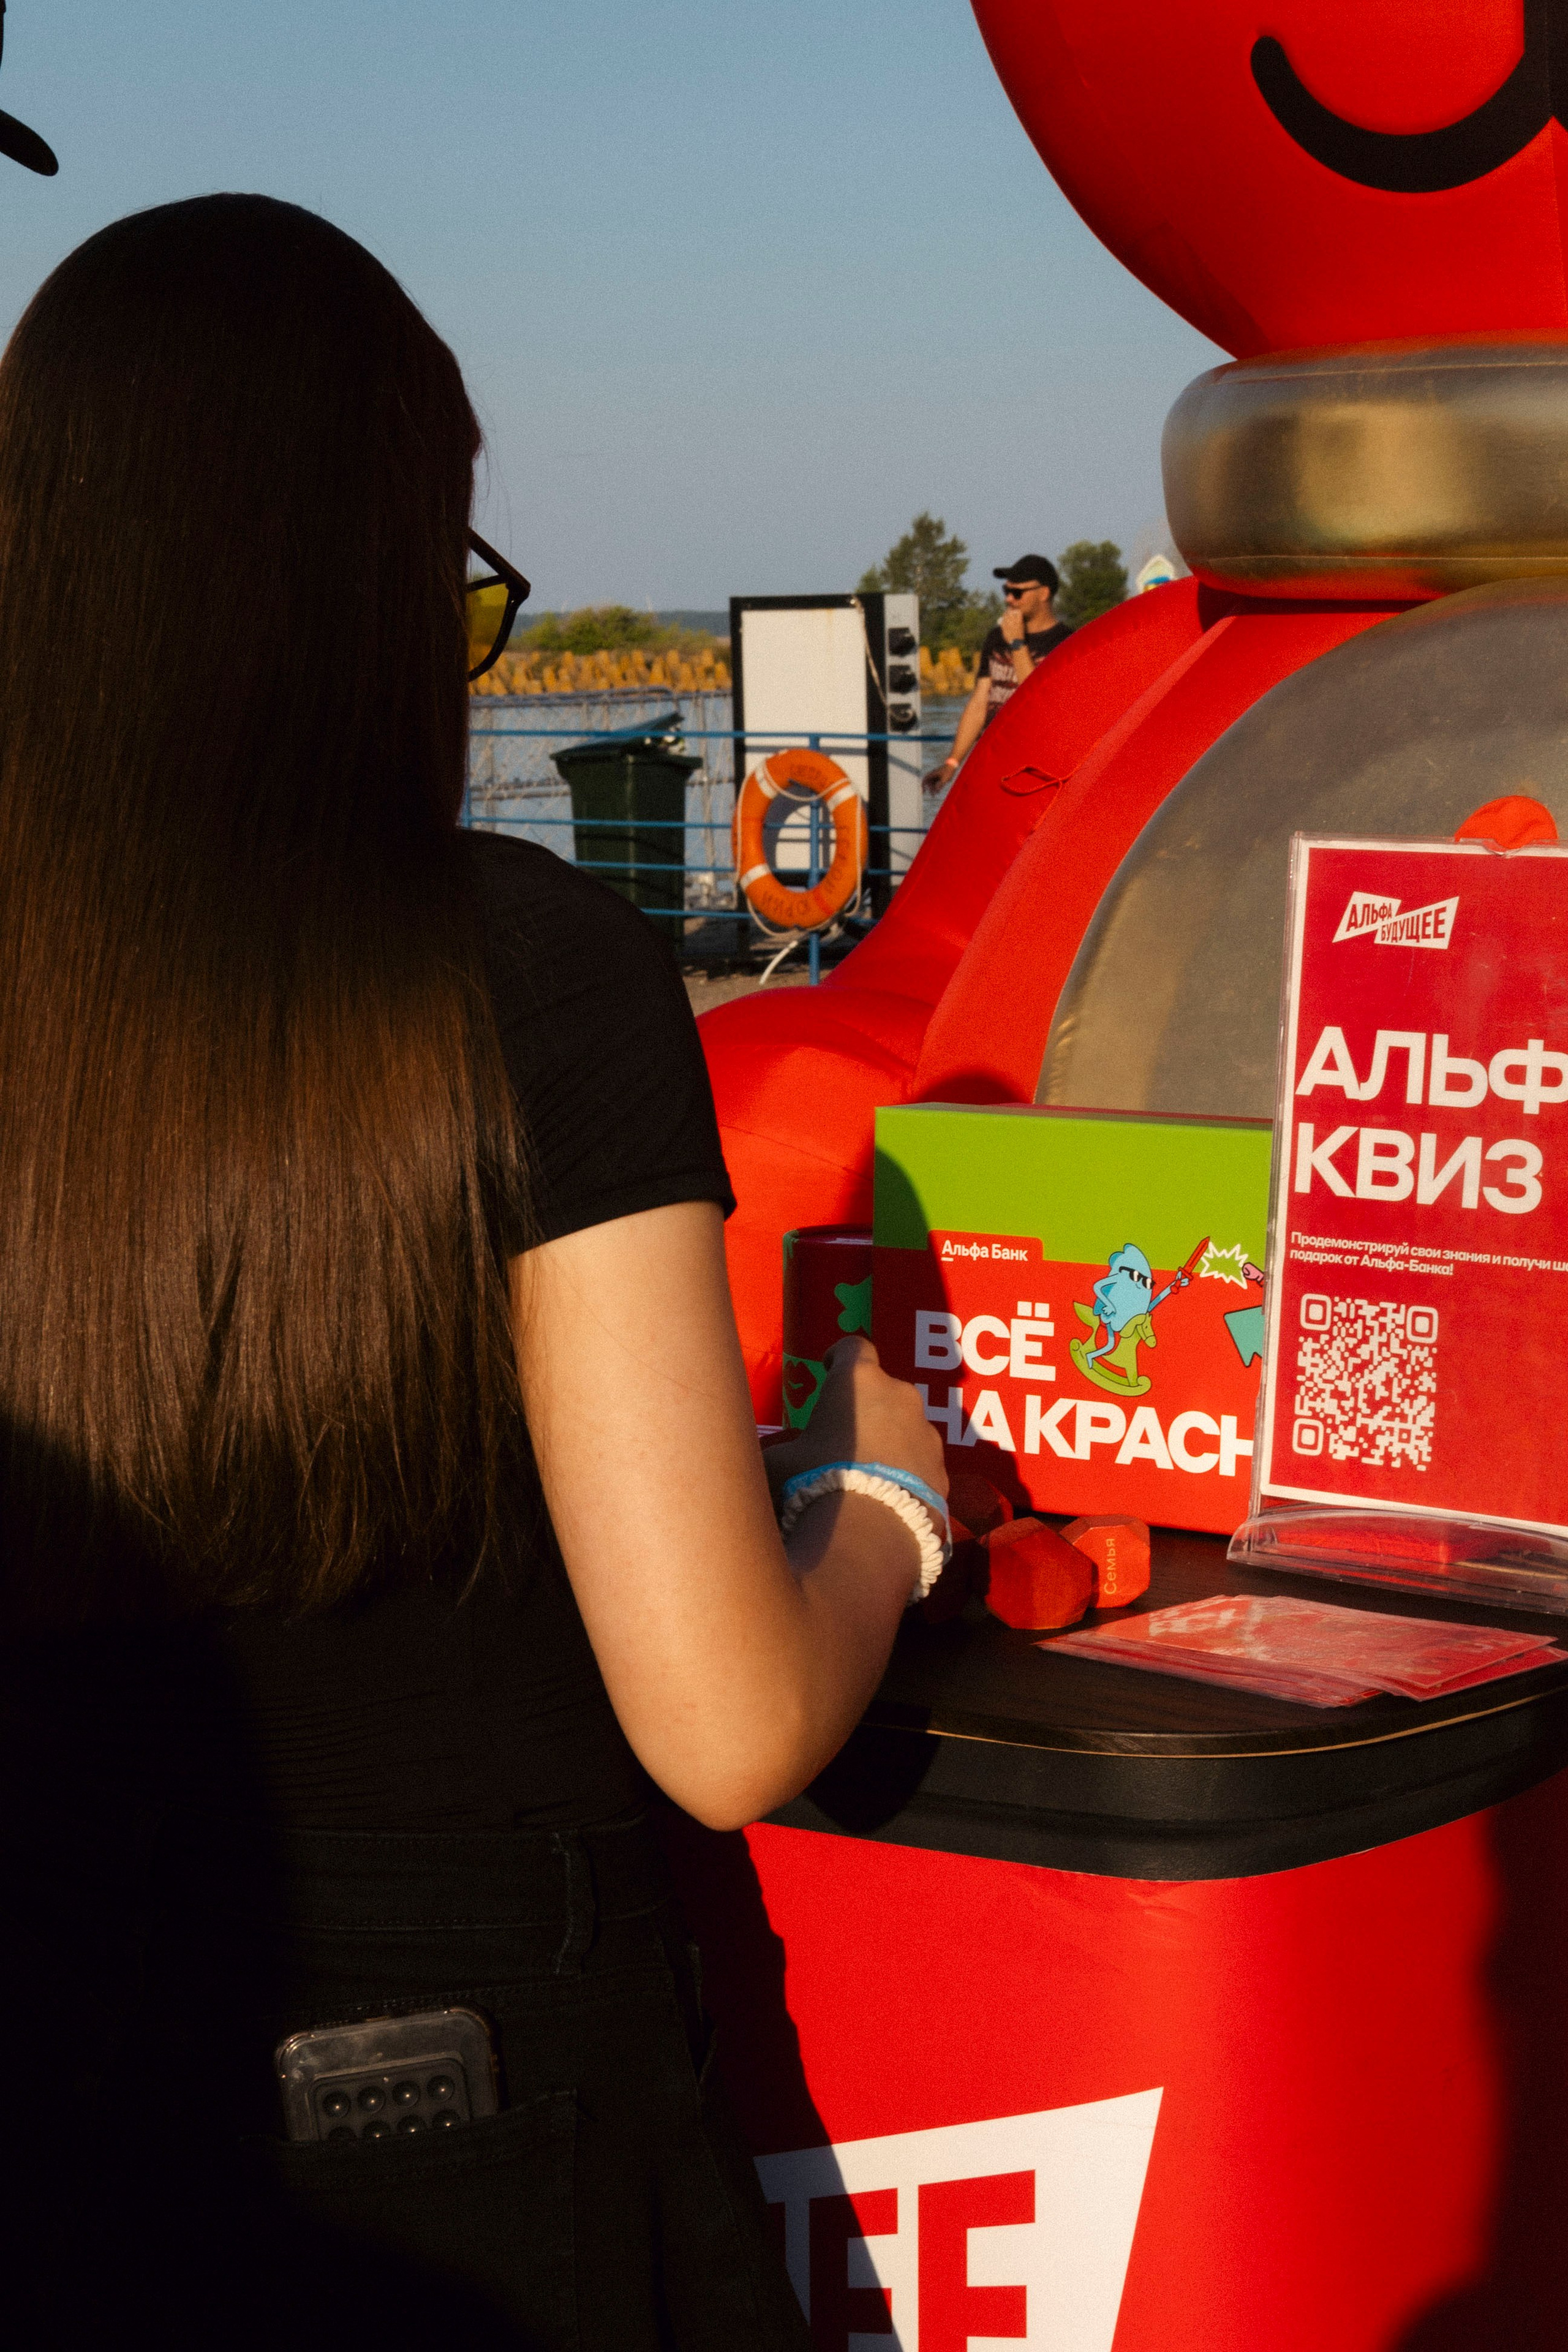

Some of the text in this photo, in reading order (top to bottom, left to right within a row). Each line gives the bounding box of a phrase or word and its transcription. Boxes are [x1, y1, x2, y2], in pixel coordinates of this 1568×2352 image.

[1346, 903, 1392, 932] АЛЬФА
[1381, 906, 1447, 943] БУДУЩЕЕ
[1295, 1026, 1568, 1114] АЛЬФ
[1294, 1123, 1544, 1214] КВИЗ
[941, 1240, 1028, 1261] Альфа Банк
[1290, 1249, 1453, 1276] подарок от Альфа-Банка!
[1291, 1231, 1409, 1256] Продемонстрируй
[1411, 1246, 1441, 1259] свои
[1442, 1250, 1491, 1264] знания
[1492, 1255, 1501, 1264] и
[1502, 1256, 1551, 1271] получи
[915, 1301, 1056, 1382] ВСЁ
[915, 1383, 1016, 1452] НА
[1104, 1538, 1117, 1595] Семья
